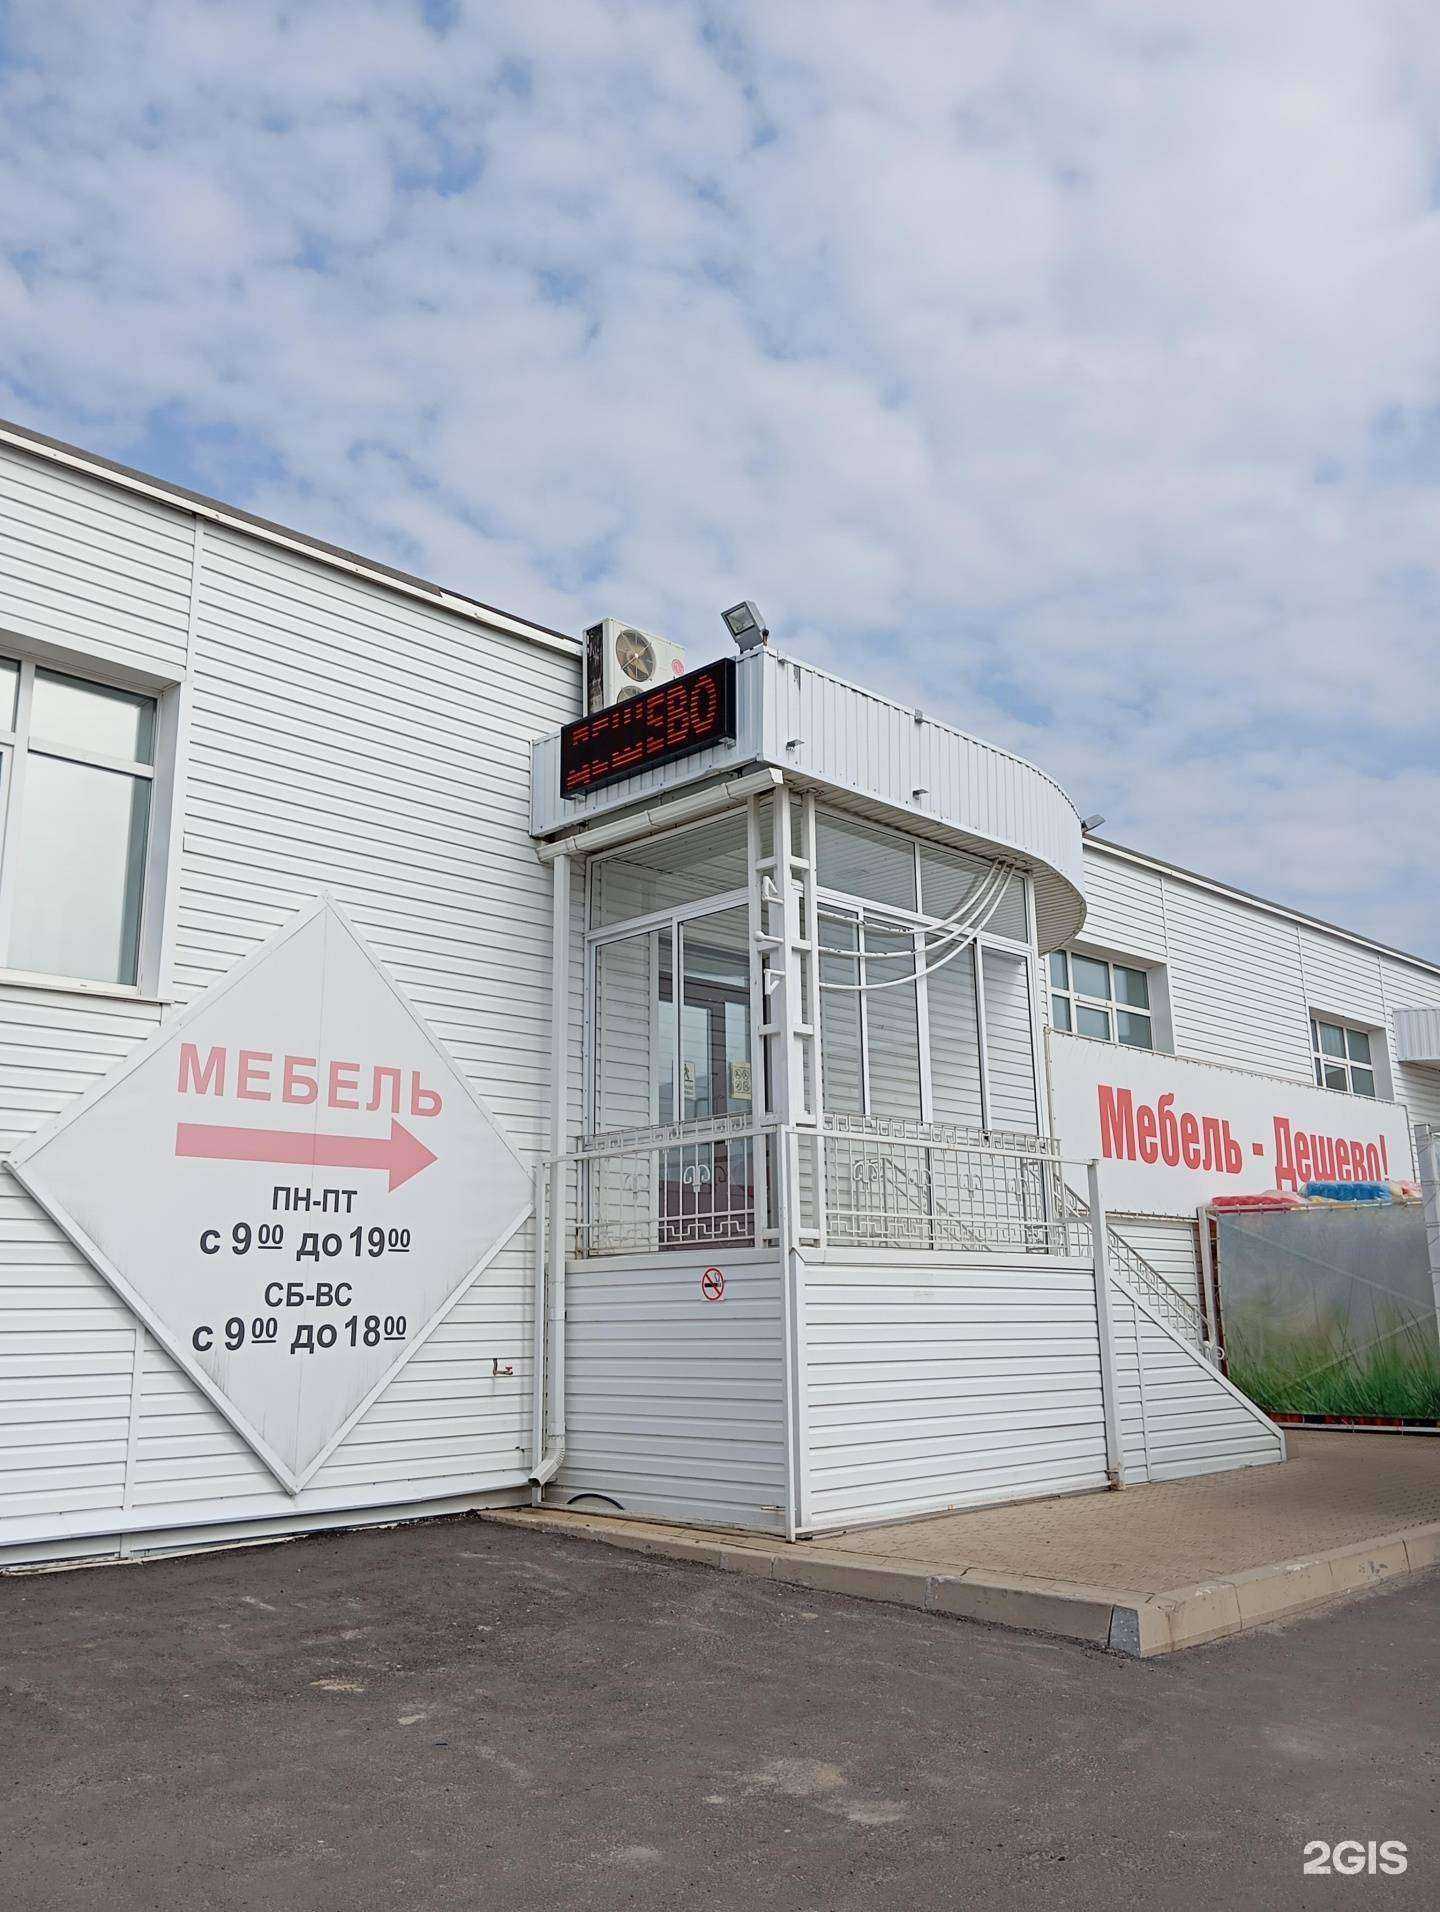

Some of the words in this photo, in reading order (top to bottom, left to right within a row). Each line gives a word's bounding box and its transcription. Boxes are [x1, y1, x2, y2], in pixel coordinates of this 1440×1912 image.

[177, 1042, 443, 1118] МЕБЕЛЬ
[1097, 1083, 1244, 1175] Мебель
[1272, 1115, 1390, 1193] Дешево!
[272, 1186, 358, 1213] ПН-ПТ
[199, 1229, 221, 1255] с
[296, 1232, 342, 1261] до
[264, 1282, 352, 1307] СБ-ВС
[192, 1325, 214, 1351] с
[290, 1323, 337, 1354] до
